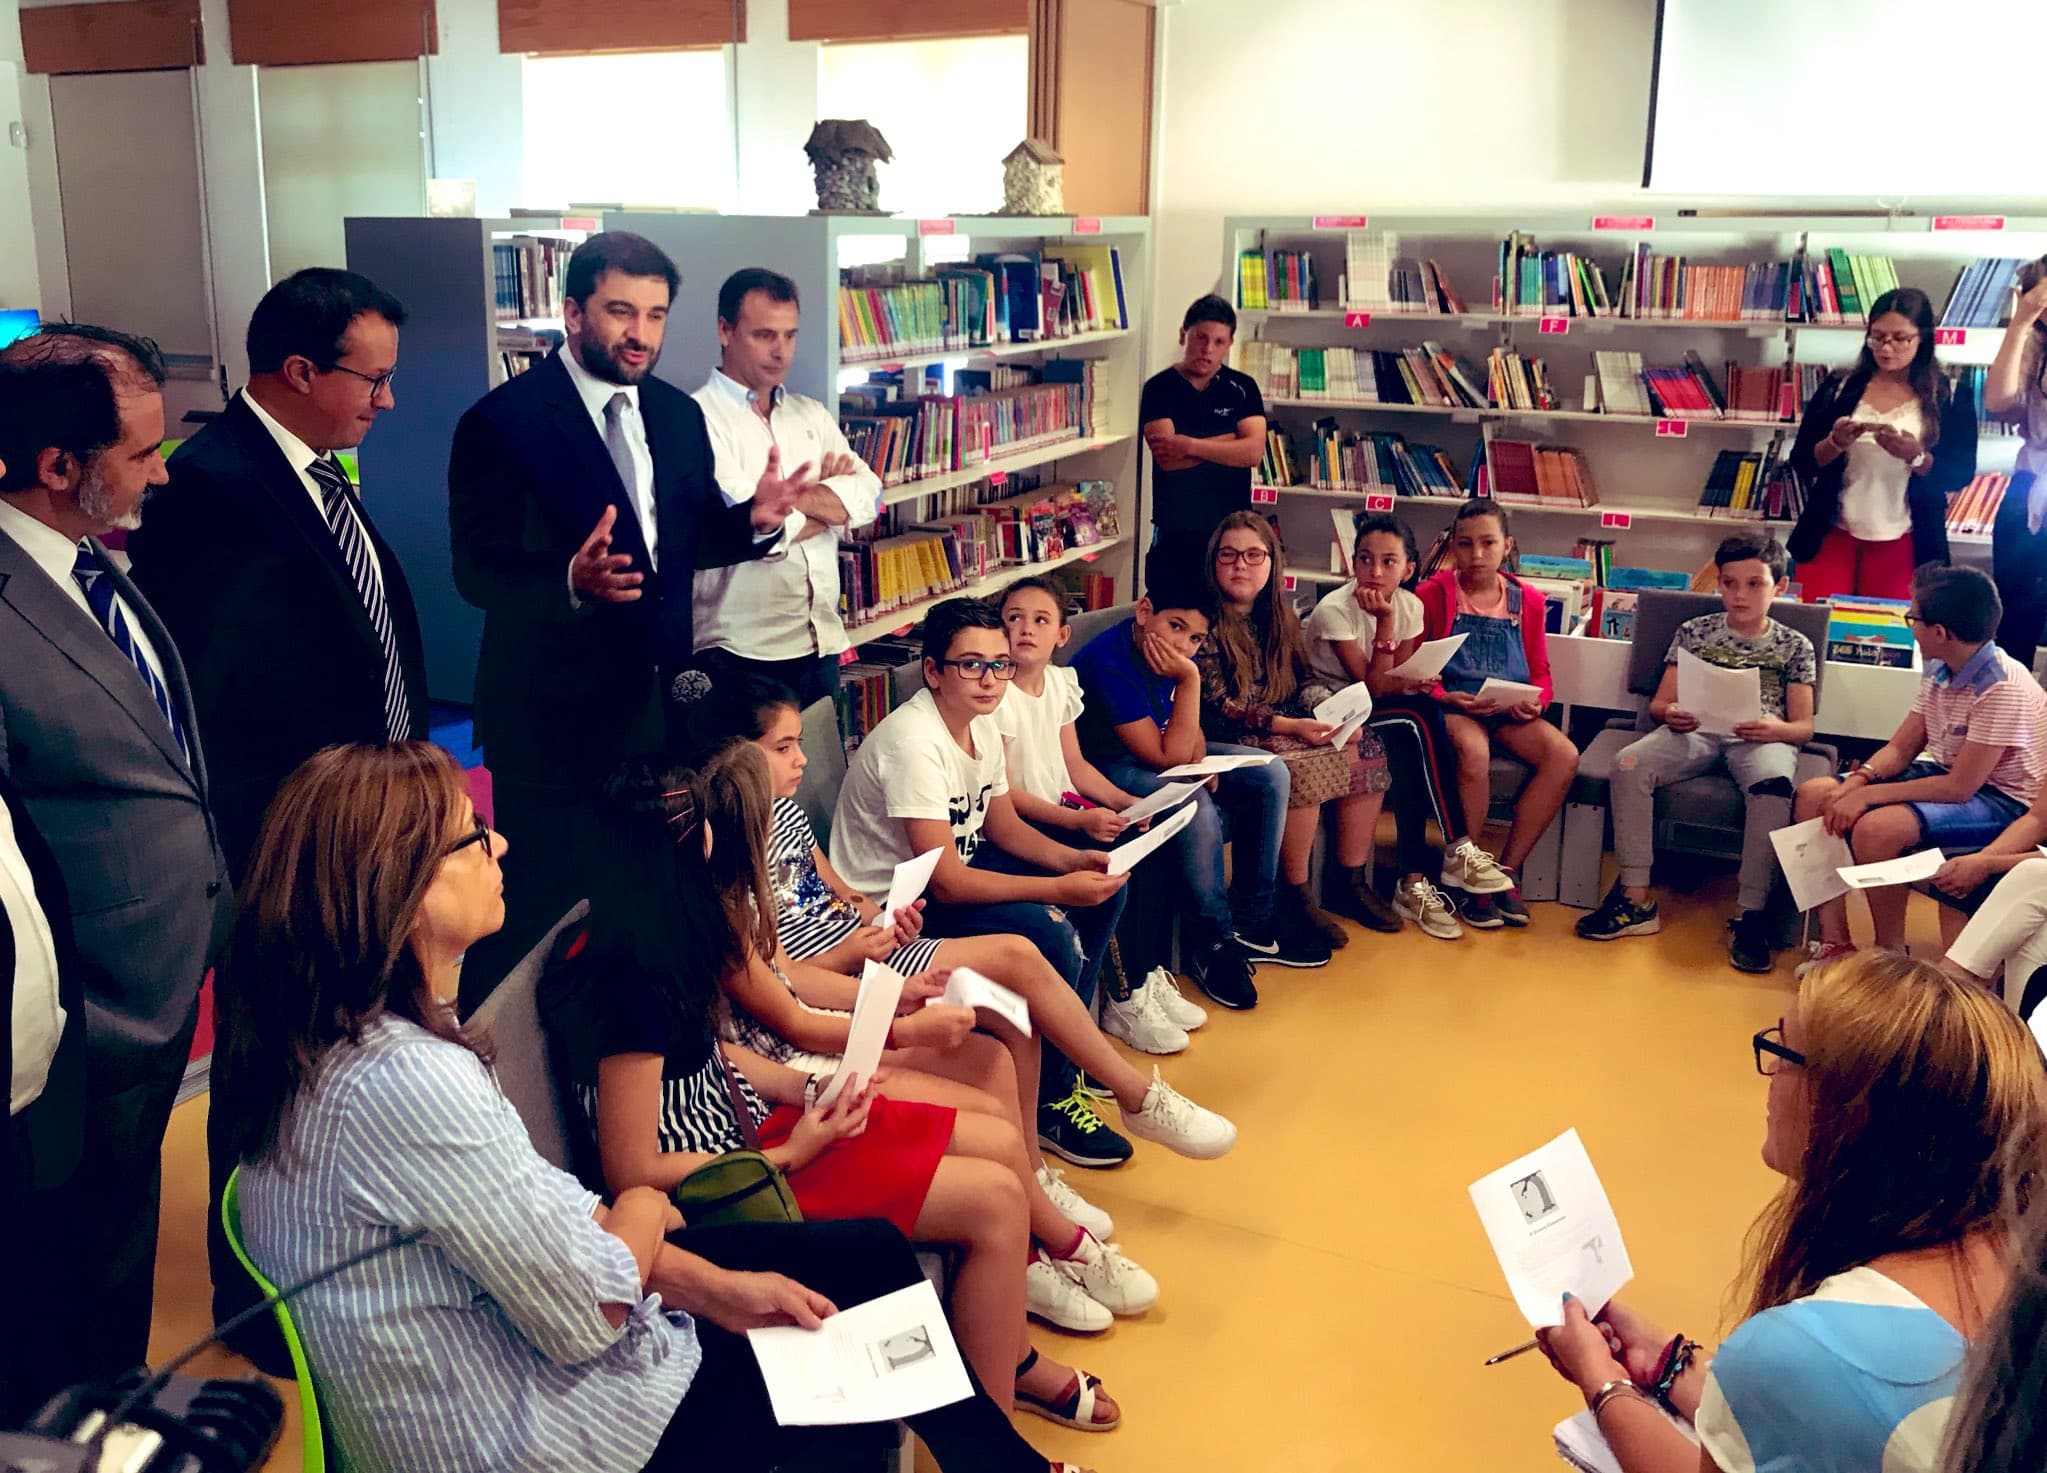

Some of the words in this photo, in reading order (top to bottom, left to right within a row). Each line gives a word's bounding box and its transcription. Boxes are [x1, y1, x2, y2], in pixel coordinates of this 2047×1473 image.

[1352, 314, 1363, 328] A
[1942, 331, 1958, 345] M
[1374, 497, 1385, 510] C
